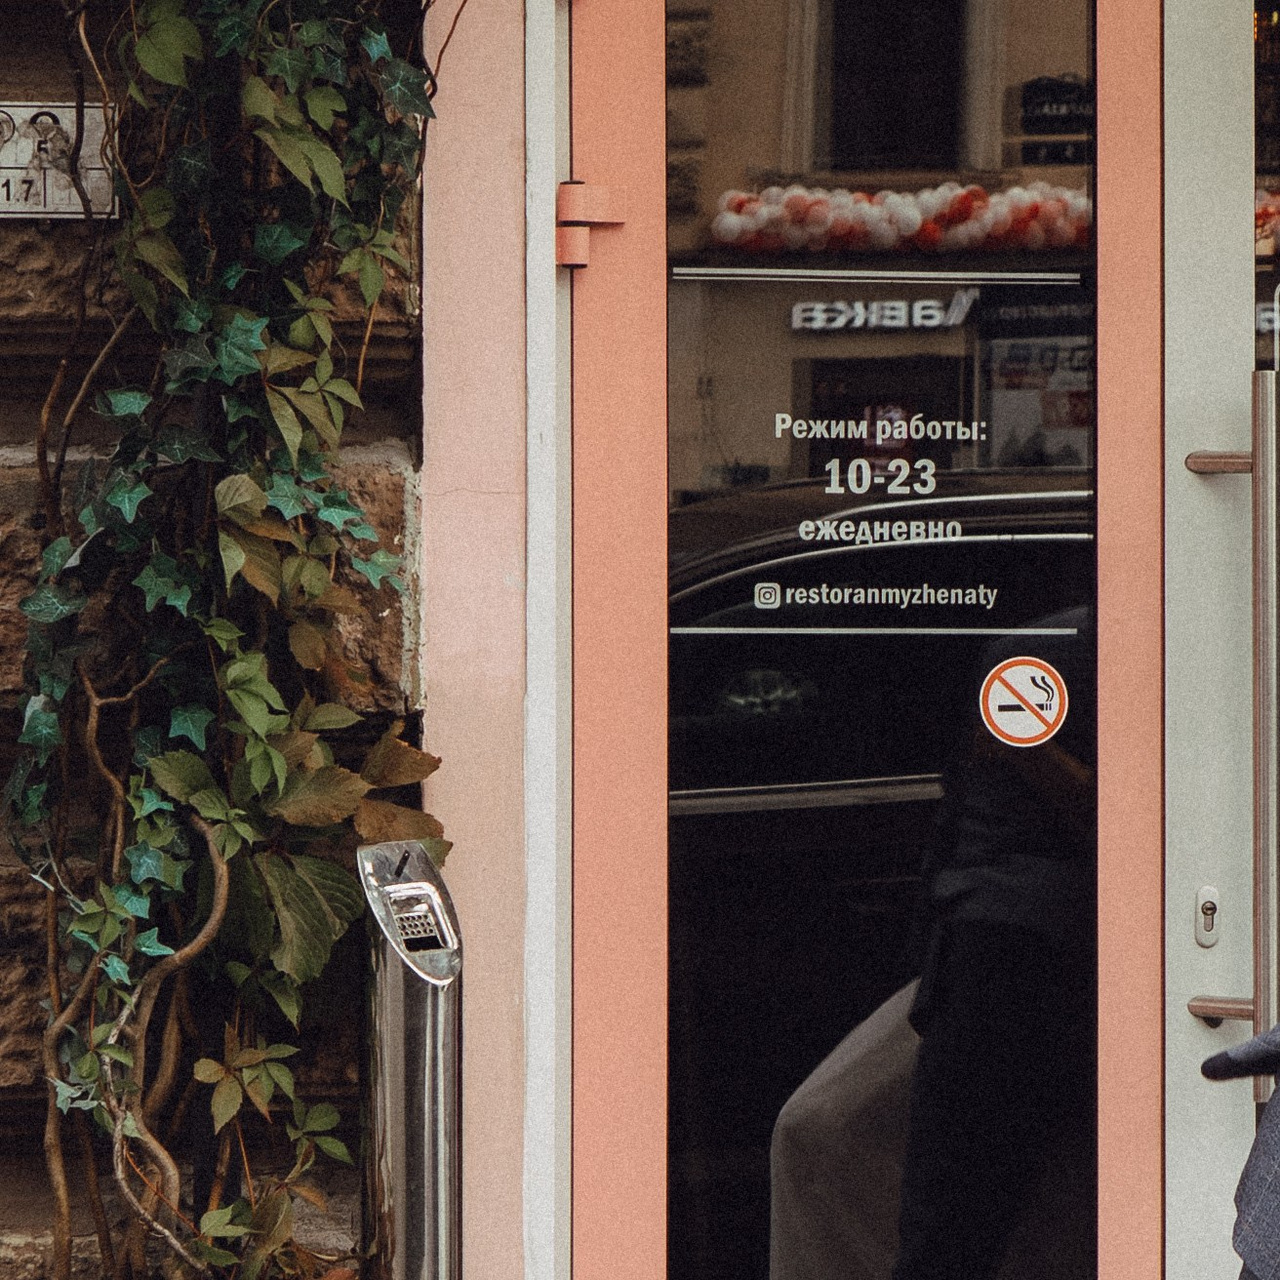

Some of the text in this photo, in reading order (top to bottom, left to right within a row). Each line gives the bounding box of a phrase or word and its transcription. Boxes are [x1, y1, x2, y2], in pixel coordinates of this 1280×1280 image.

[774, 413, 988, 446] Режим работы:
[824, 458, 937, 495] 10-23
[798, 520, 963, 546] ежедневно
[785, 583, 998, 610] restoranmyzhenaty
